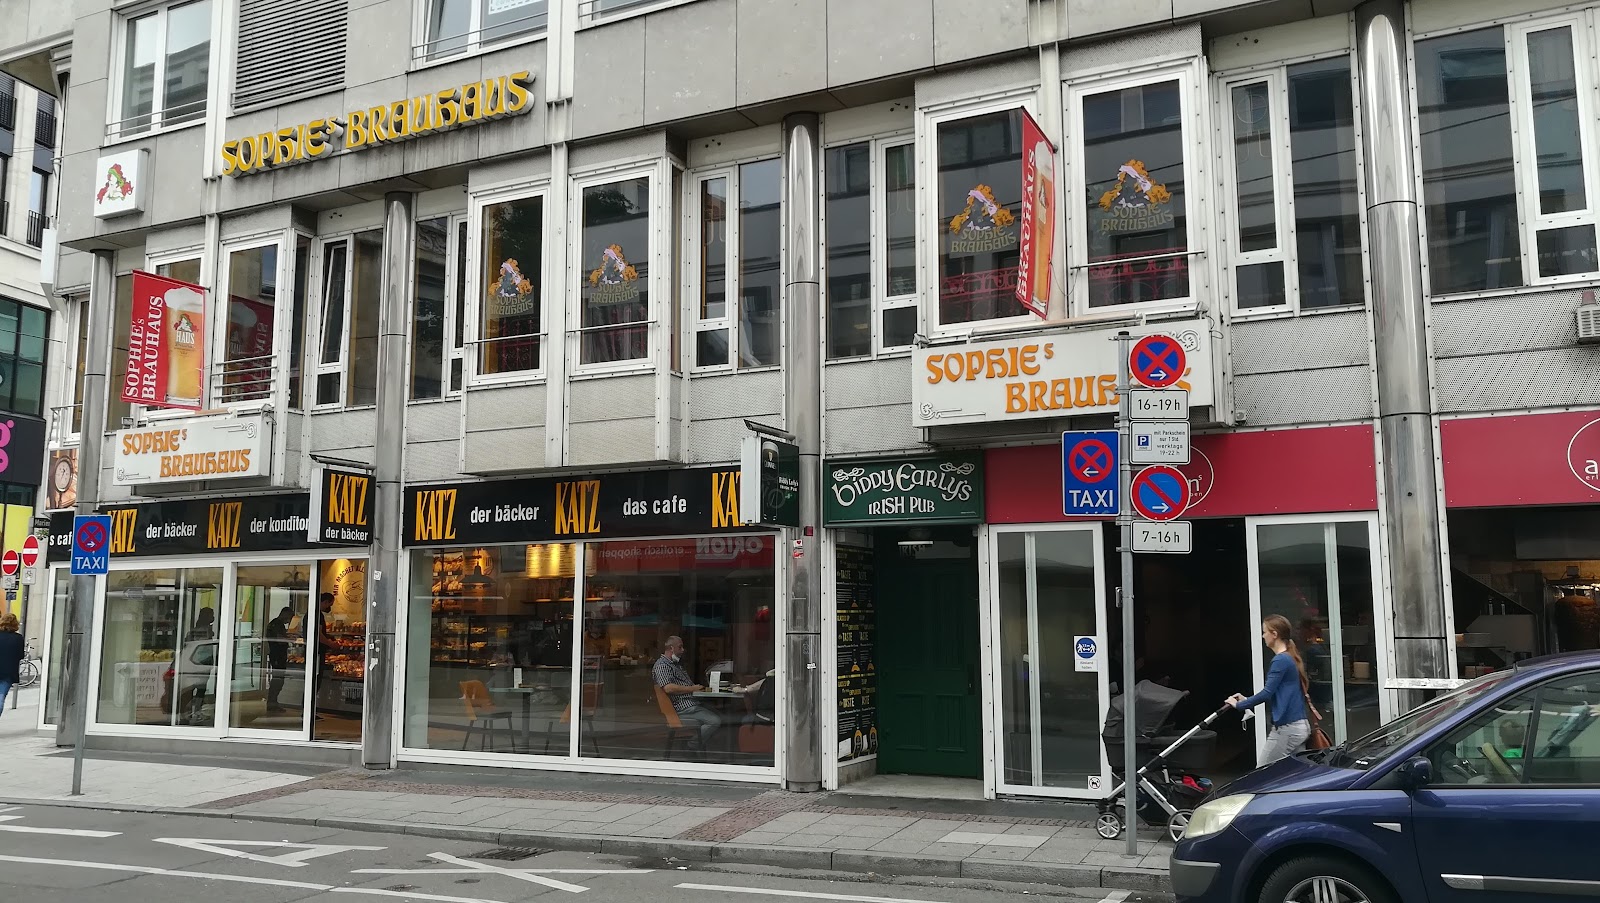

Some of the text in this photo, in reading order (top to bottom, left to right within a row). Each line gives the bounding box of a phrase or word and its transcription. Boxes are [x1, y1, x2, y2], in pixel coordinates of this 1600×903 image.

[345, 70, 532, 150] BRAUHAUS
[1101, 211, 1174, 232] BRAUHAUS
[950, 232, 1017, 254] BRAUHAUS
[590, 286, 640, 304] BRAUHAUS
[141, 295, 164, 400] BRAUHAUS
[159, 448, 252, 478] BRAUHAUS
[328, 473, 369, 526] KATZ
[554, 480, 601, 535] KATZ
[623, 494, 687, 516] das cafe
[868, 496, 935, 515] IRISH PUB
[1069, 489, 1114, 508] TAXI
[414, 488, 458, 541] KATZ
[470, 503, 540, 524] der bäcker
[146, 521, 198, 539] der bäcker
[207, 501, 243, 549] KATZ
[250, 517, 267, 533] der
[325, 527, 369, 541] der bäcker
[57, 531, 73, 546] caf
[75, 556, 105, 569] TAXI
